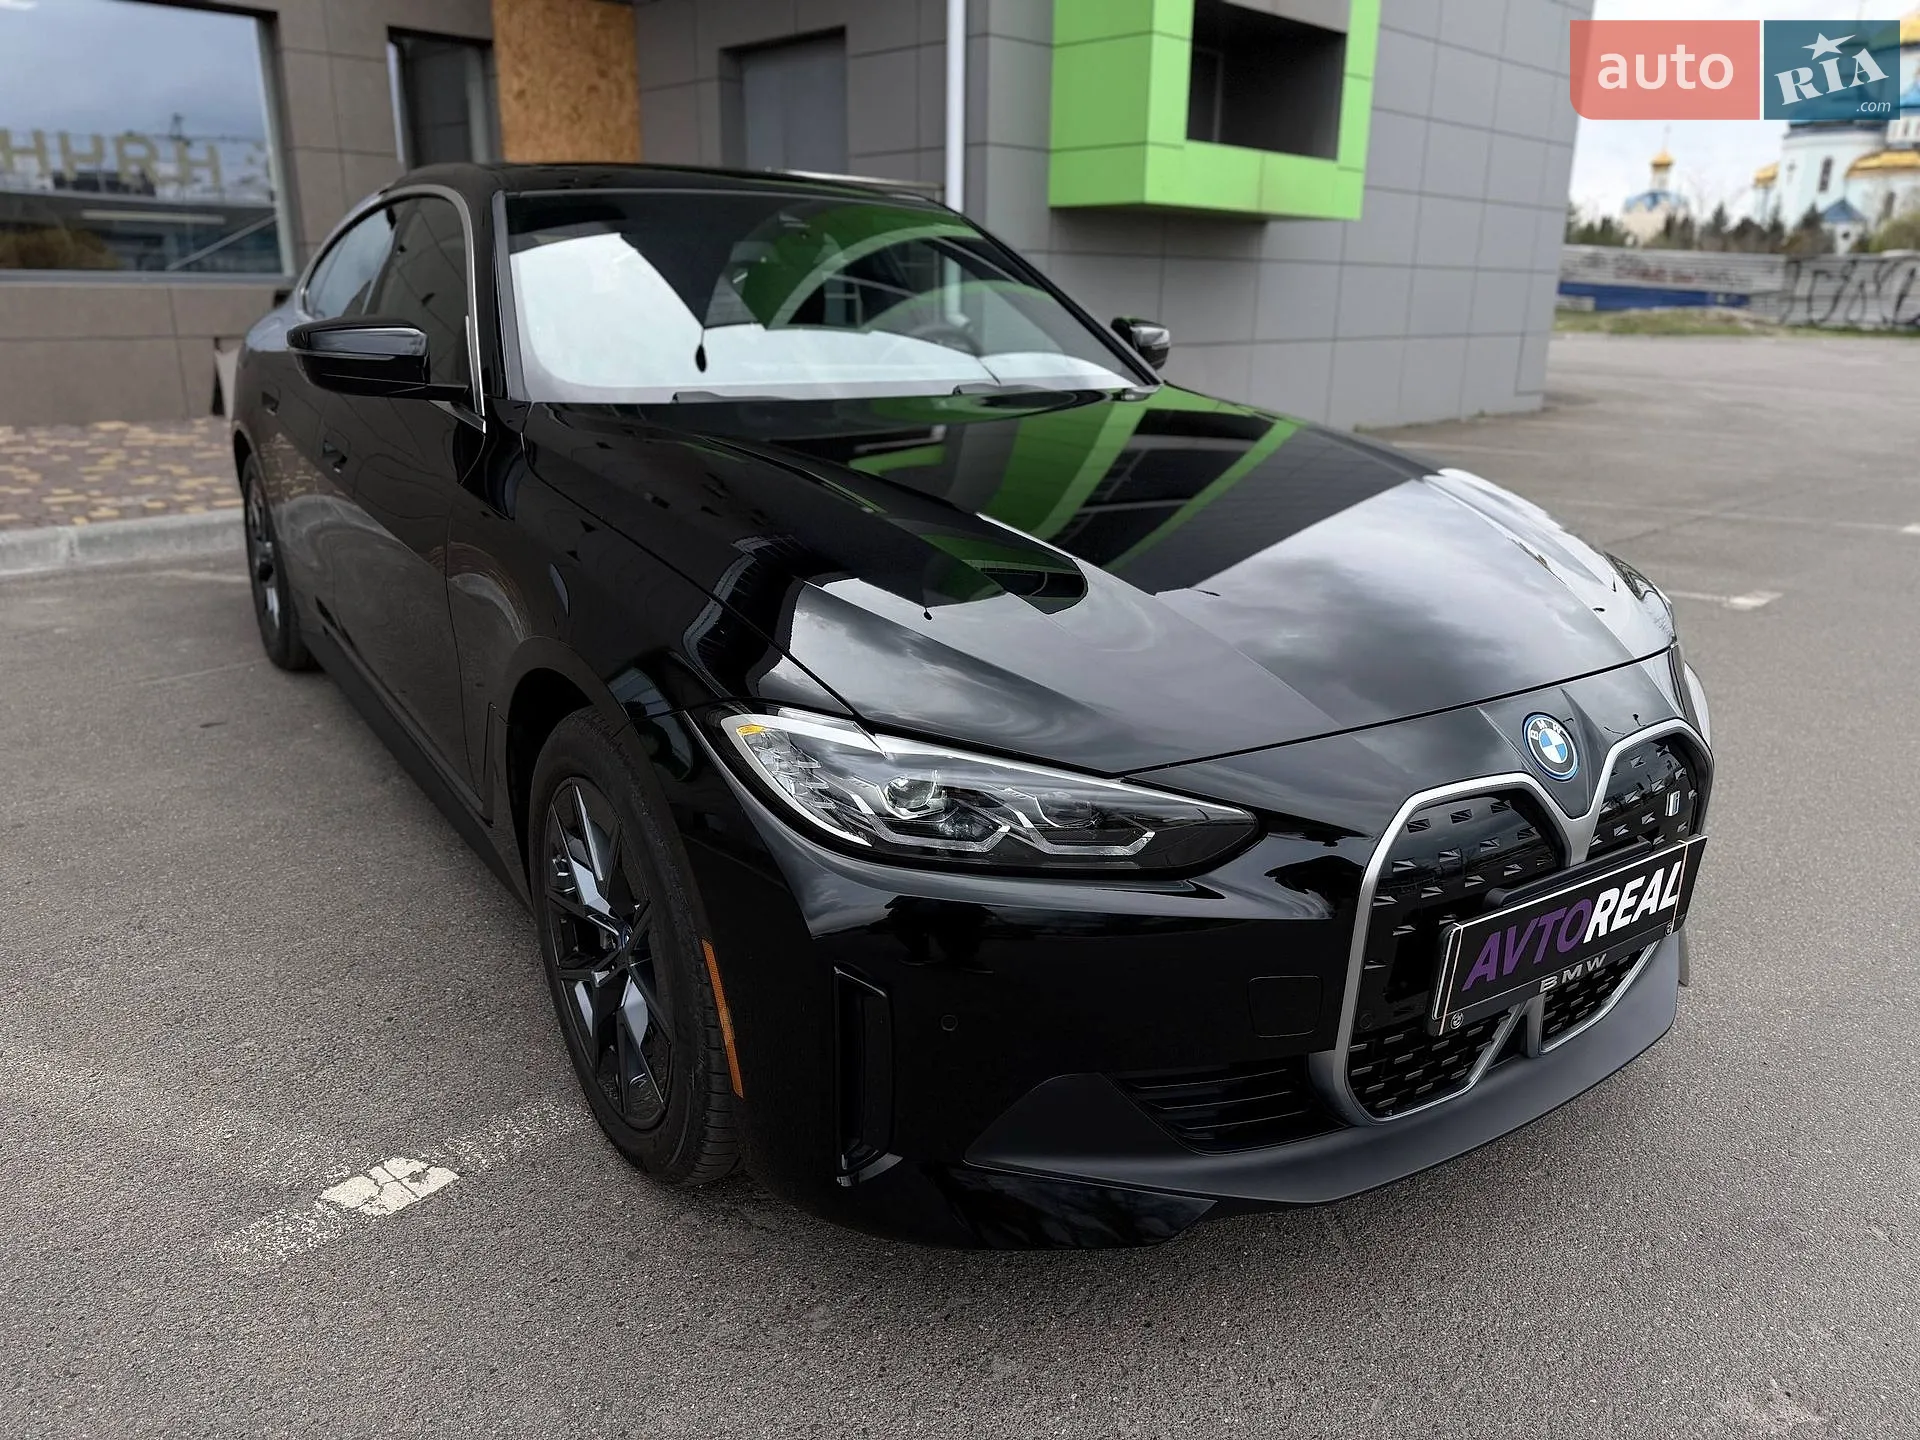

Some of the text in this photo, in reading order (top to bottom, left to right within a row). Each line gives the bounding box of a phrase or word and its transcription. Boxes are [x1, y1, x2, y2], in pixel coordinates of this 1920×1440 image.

[1530, 719, 1562, 741] BMW
[1461, 860, 1683, 993] AVTOREAL
[1539, 953, 1607, 993] BMW
